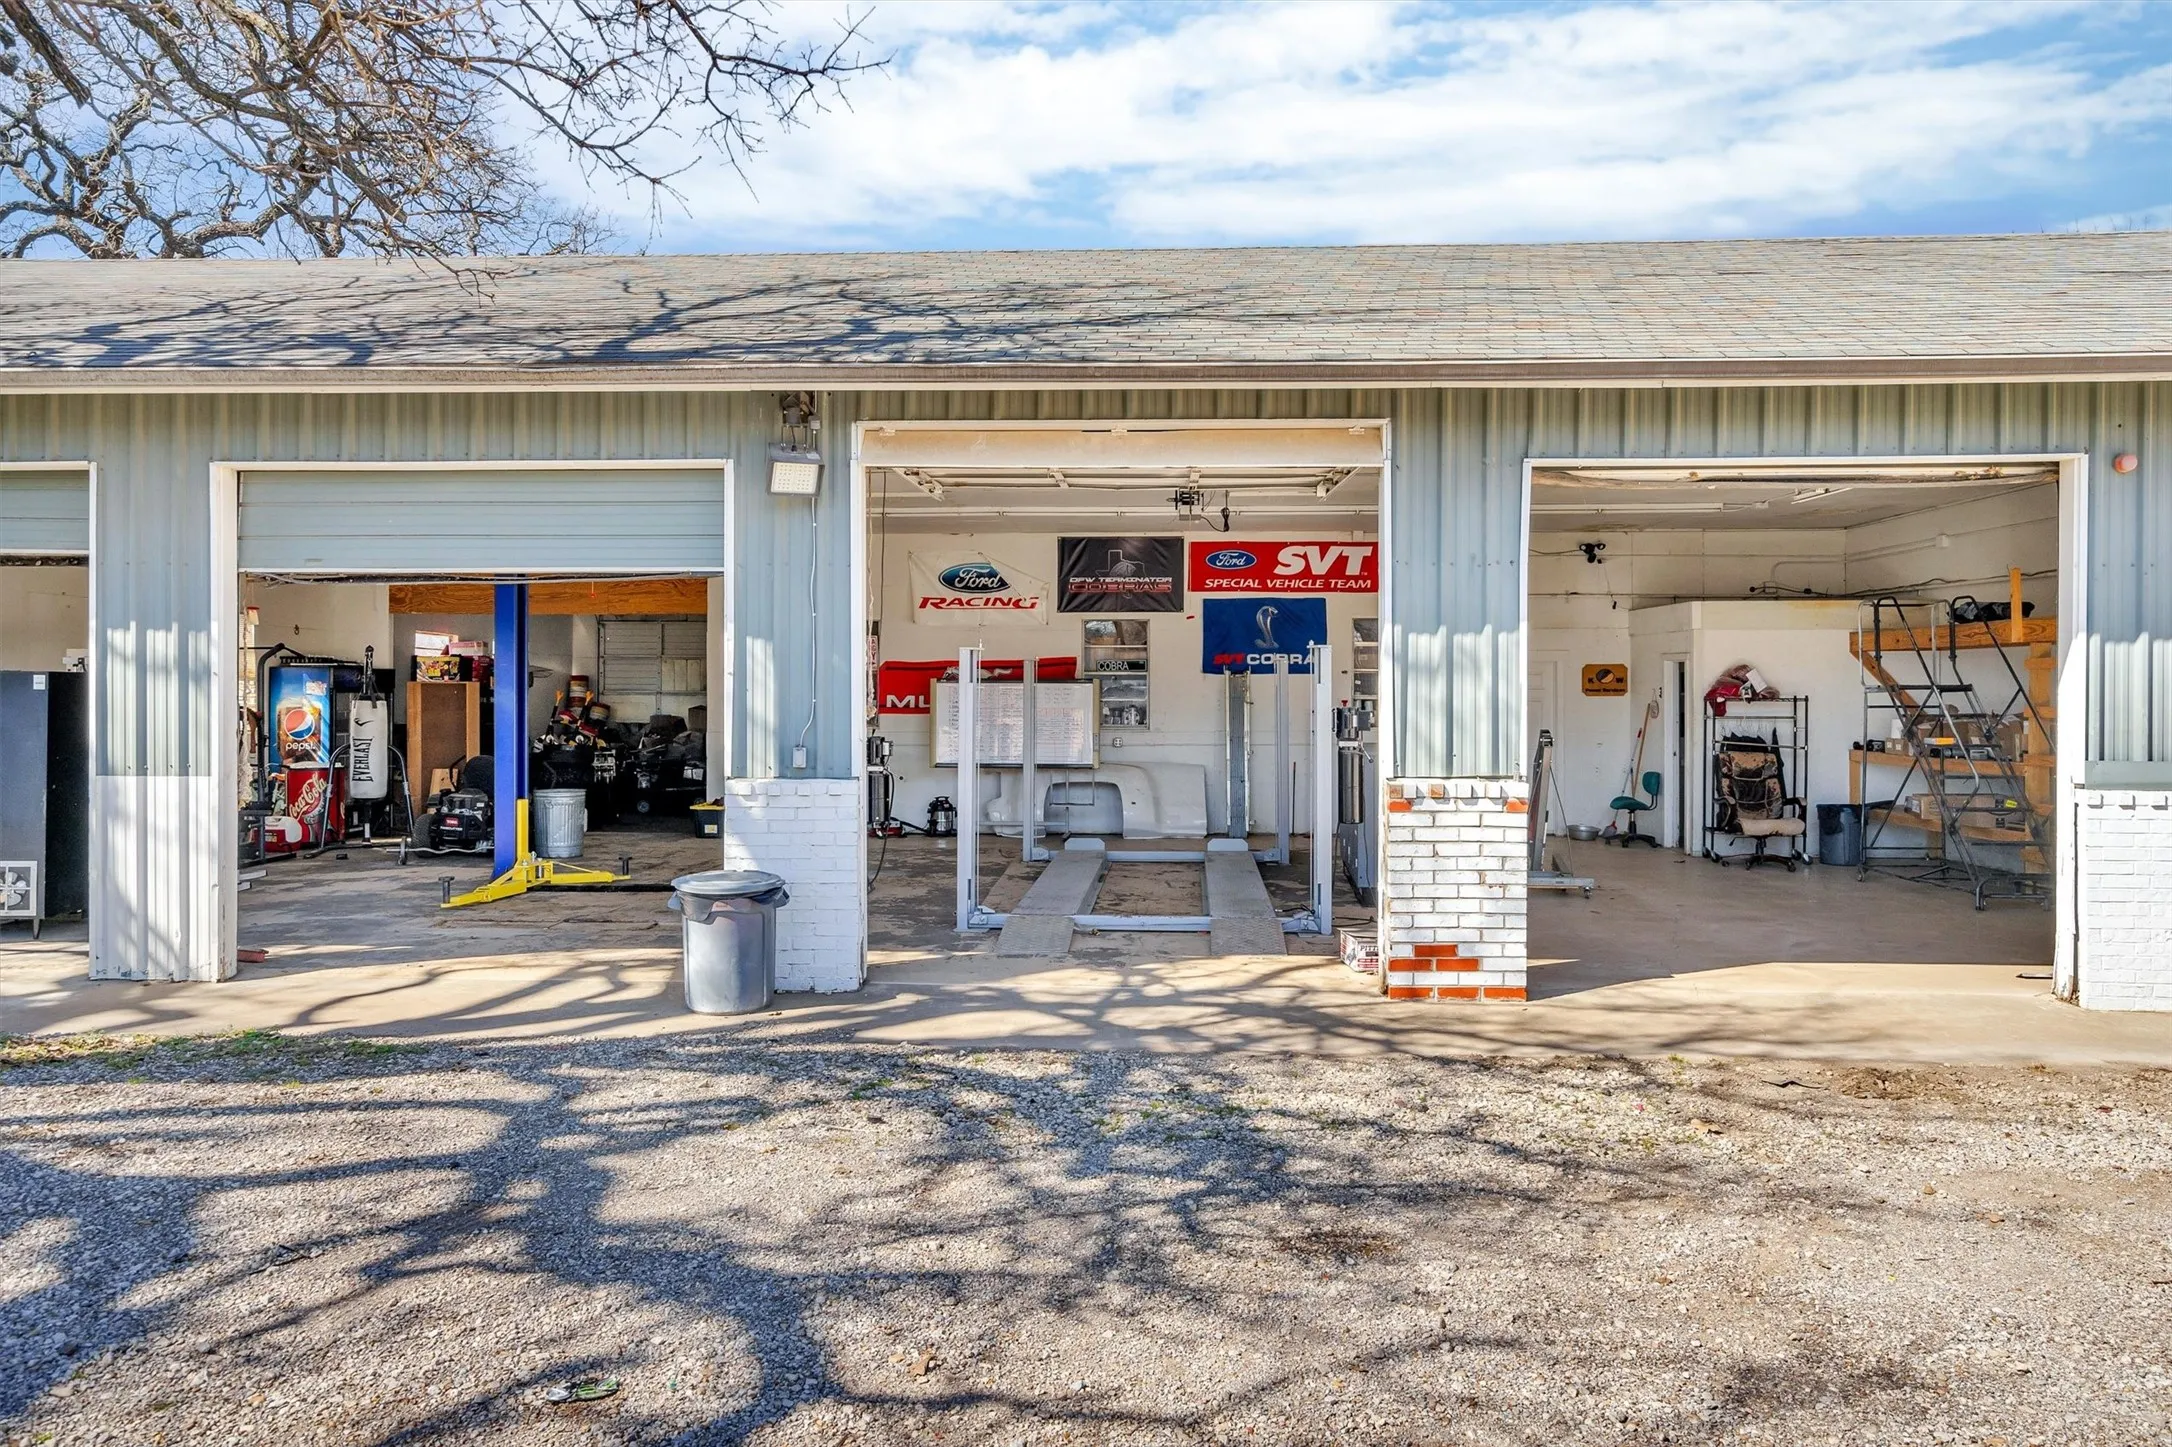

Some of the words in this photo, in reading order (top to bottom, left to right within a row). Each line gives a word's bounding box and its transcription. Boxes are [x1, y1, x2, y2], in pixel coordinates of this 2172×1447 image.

[1215, 552, 1247, 566] Ford
[1273, 545, 1373, 576] SVT
[954, 567, 1001, 588] Ford
[1204, 578, 1262, 588] SPECIAL
[1266, 578, 1324, 588] VEHICLE
[1328, 578, 1372, 588] TEAM
[1068, 582, 1172, 593] COBRAS
[918, 596, 1040, 610] RACING
[1098, 661, 1130, 671] COBRA
[886, 694, 931, 708] MU
[285, 742, 314, 752] pepsi
[352, 736, 375, 783] EVERLAST
